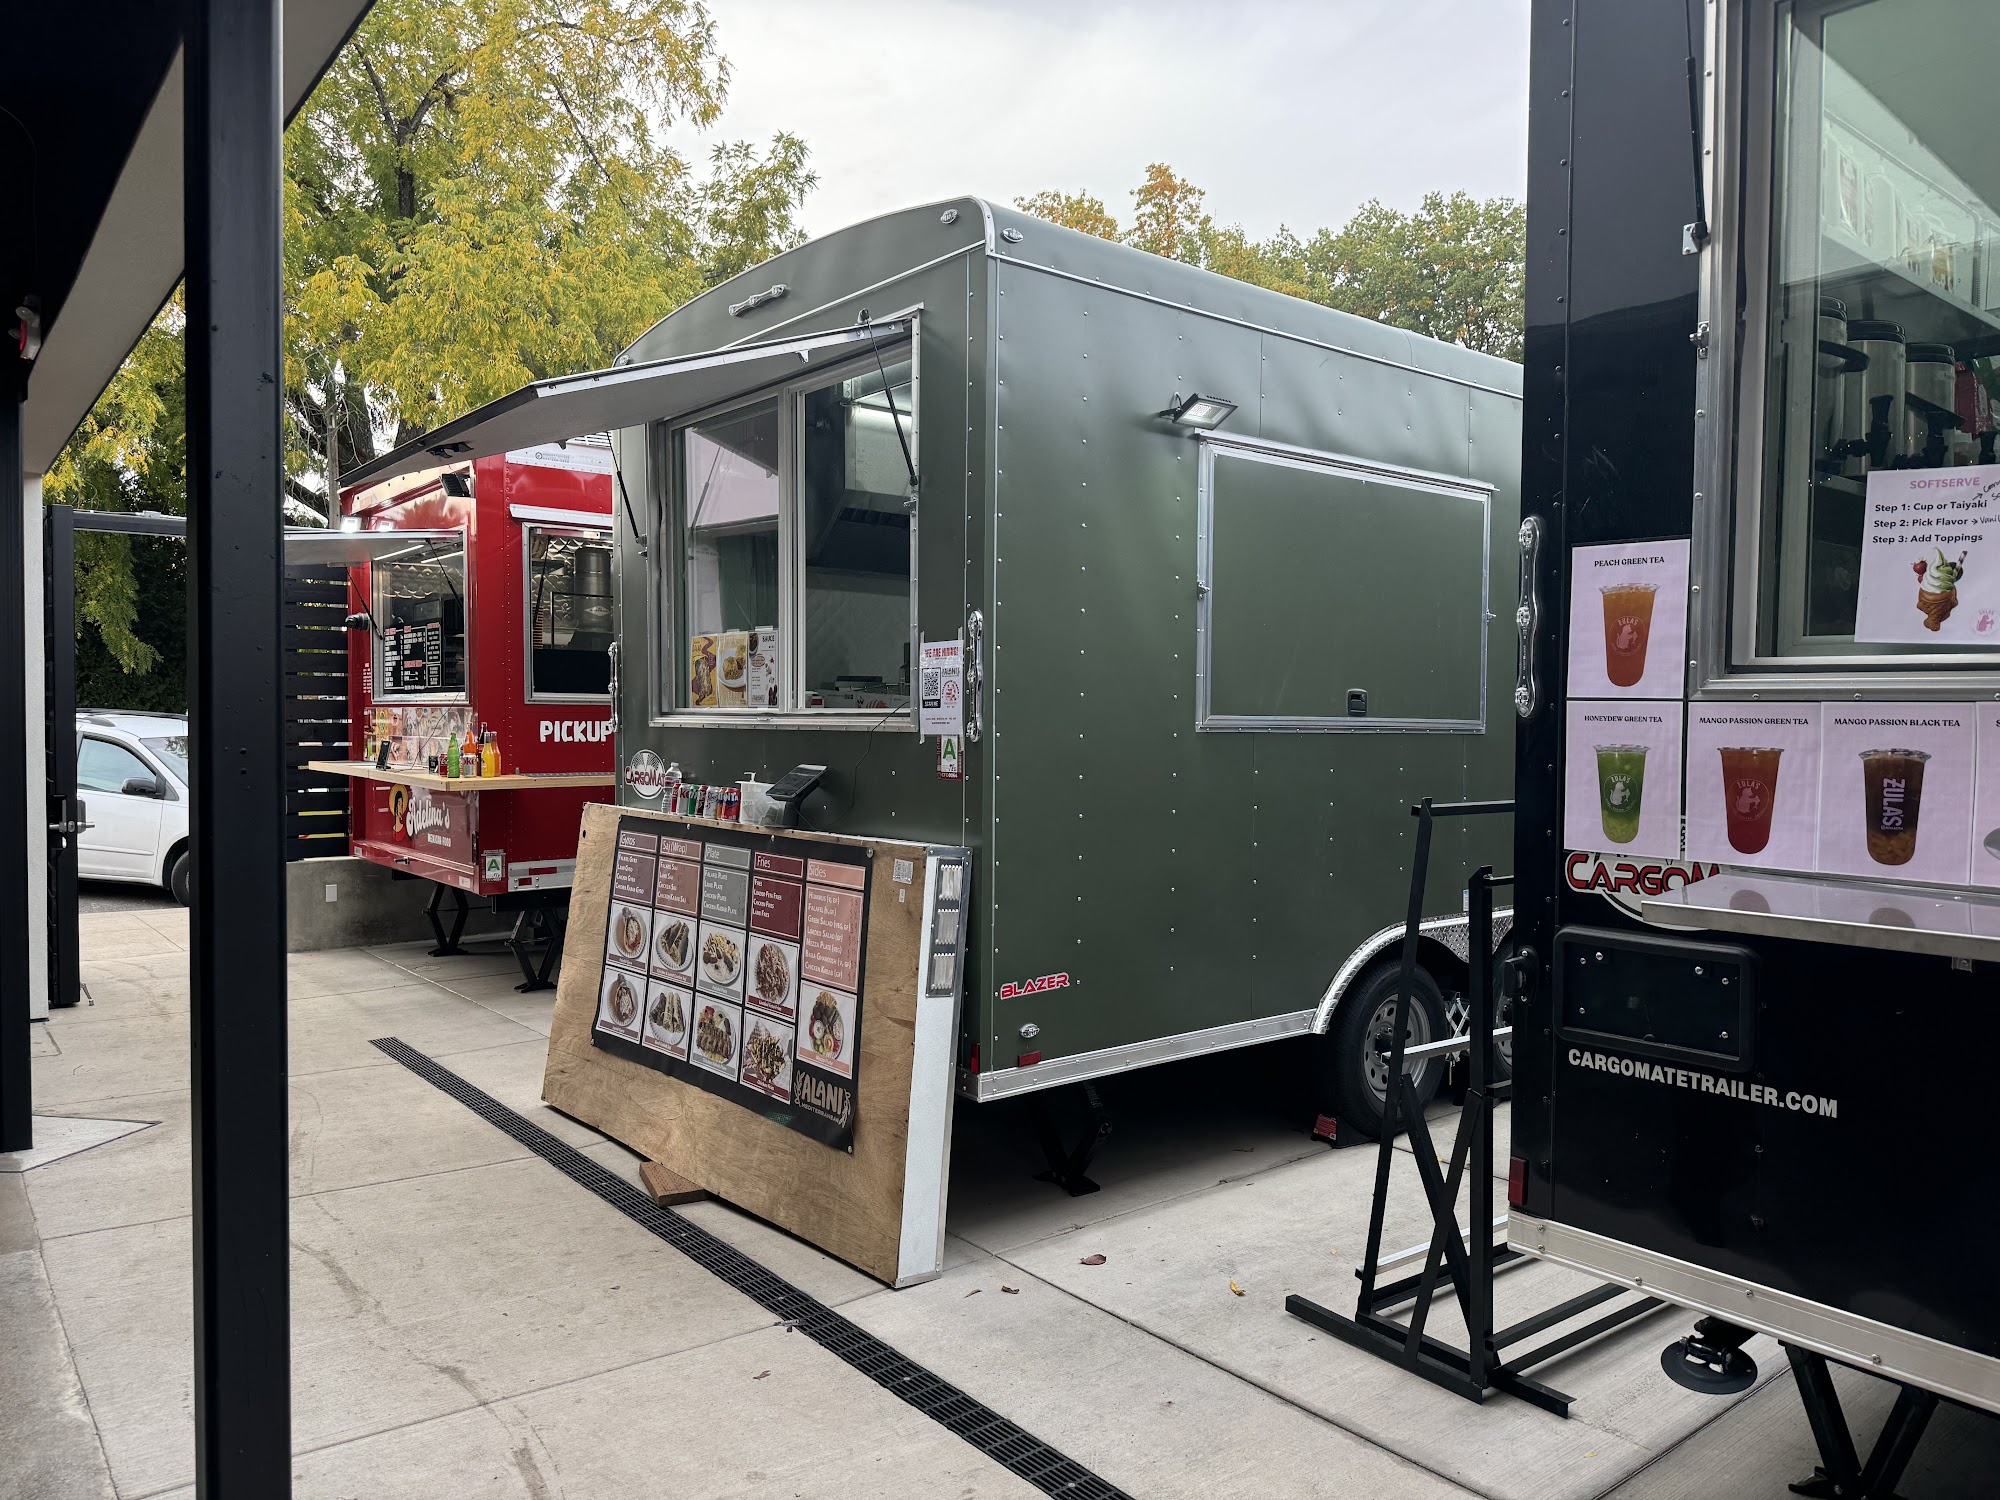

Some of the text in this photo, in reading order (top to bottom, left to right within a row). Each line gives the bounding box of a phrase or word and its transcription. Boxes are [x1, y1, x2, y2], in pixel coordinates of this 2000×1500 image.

[1910, 477, 1980, 489] SOFTSERVE
[1875, 504, 1898, 513] Step
[1914, 503, 1934, 512] Cup
[1950, 500, 1987, 509] Taiyaki
[1874, 520, 1896, 529] Step
[1936, 518, 1968, 526] Flavor
[1872, 535, 1895, 544] Step
[1935, 534, 1982, 543] Toppings
[1729, 717, 1763, 725] PASSION
[1834, 718, 1867, 726] MANGO
[1910, 719, 1941, 727] BLACK
[540, 721, 614, 742] PICKUP
[943, 739, 956, 759] A
[706, 847, 719, 859] Plate
[487, 859, 500, 871] A
[757, 856, 770, 868] Fries
[809, 864, 827, 878] Sides
[1001, 972, 1069, 999] BLAZER
[1568, 1048, 1838, 1118] CARGOMATETRAILER.COM
